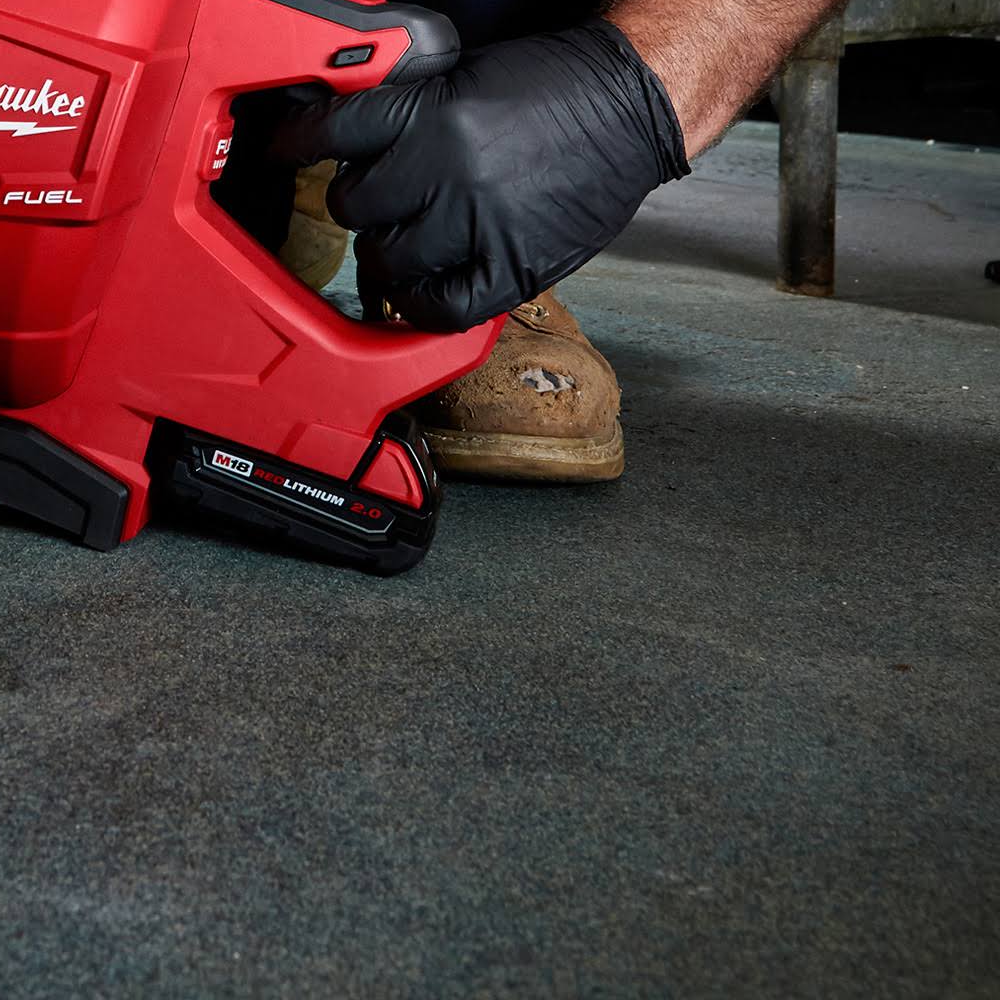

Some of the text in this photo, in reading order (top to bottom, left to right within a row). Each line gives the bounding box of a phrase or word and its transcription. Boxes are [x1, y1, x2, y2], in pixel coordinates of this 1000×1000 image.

[3, 190, 83, 205] FUEL
[215, 453, 250, 473] M18
[350, 502, 382, 519] 2.0
